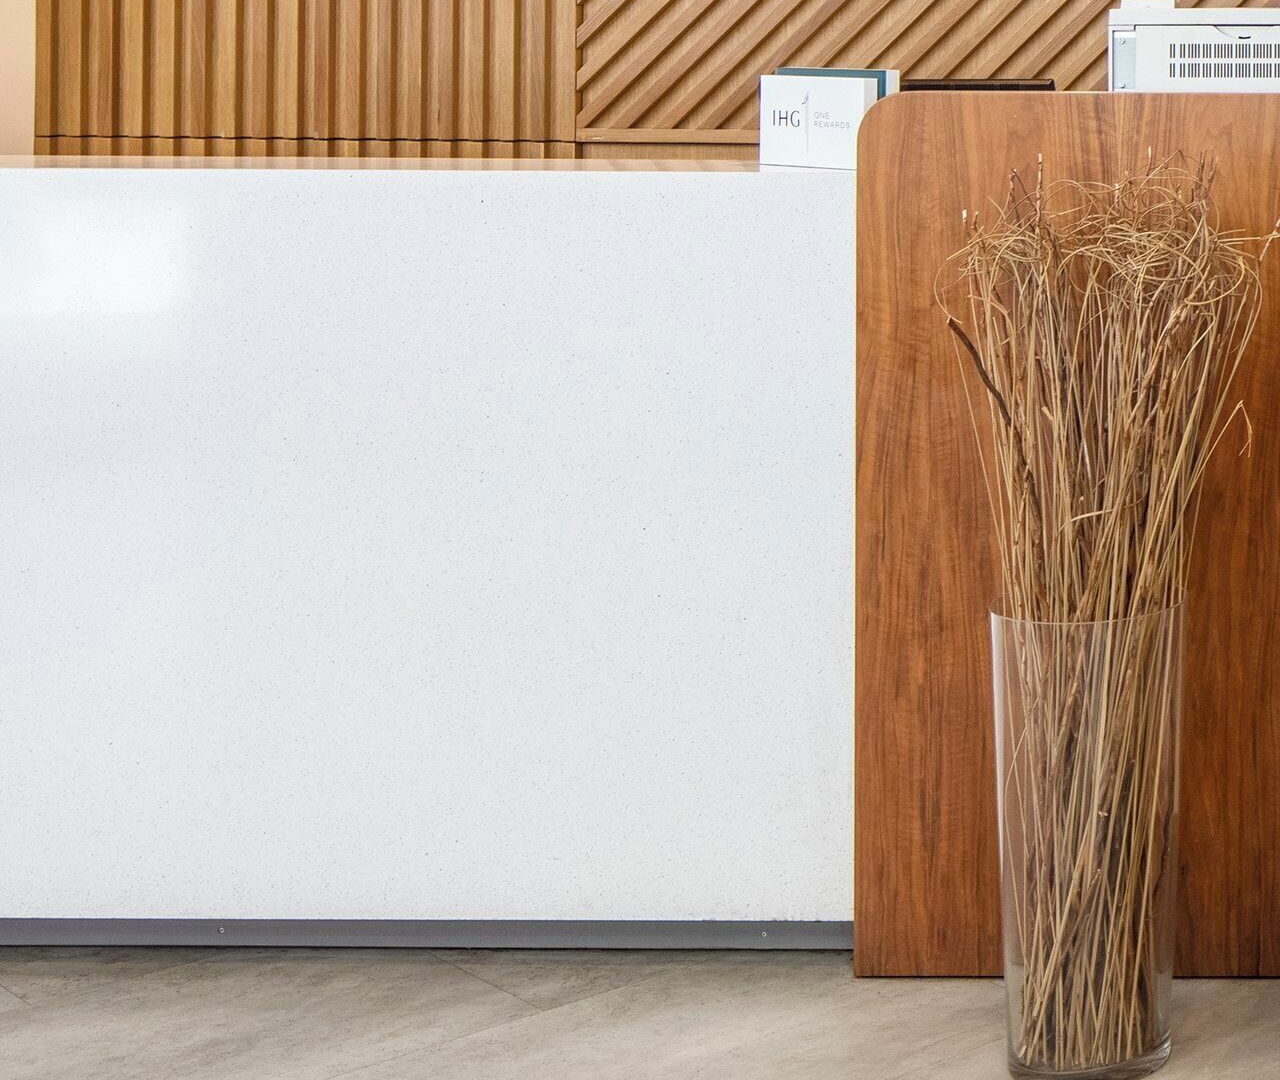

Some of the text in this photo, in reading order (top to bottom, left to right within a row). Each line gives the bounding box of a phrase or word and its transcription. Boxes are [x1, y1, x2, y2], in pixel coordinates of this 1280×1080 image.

[772, 109, 830, 128] IHG ONE
[813, 120, 851, 130] REWARDS
